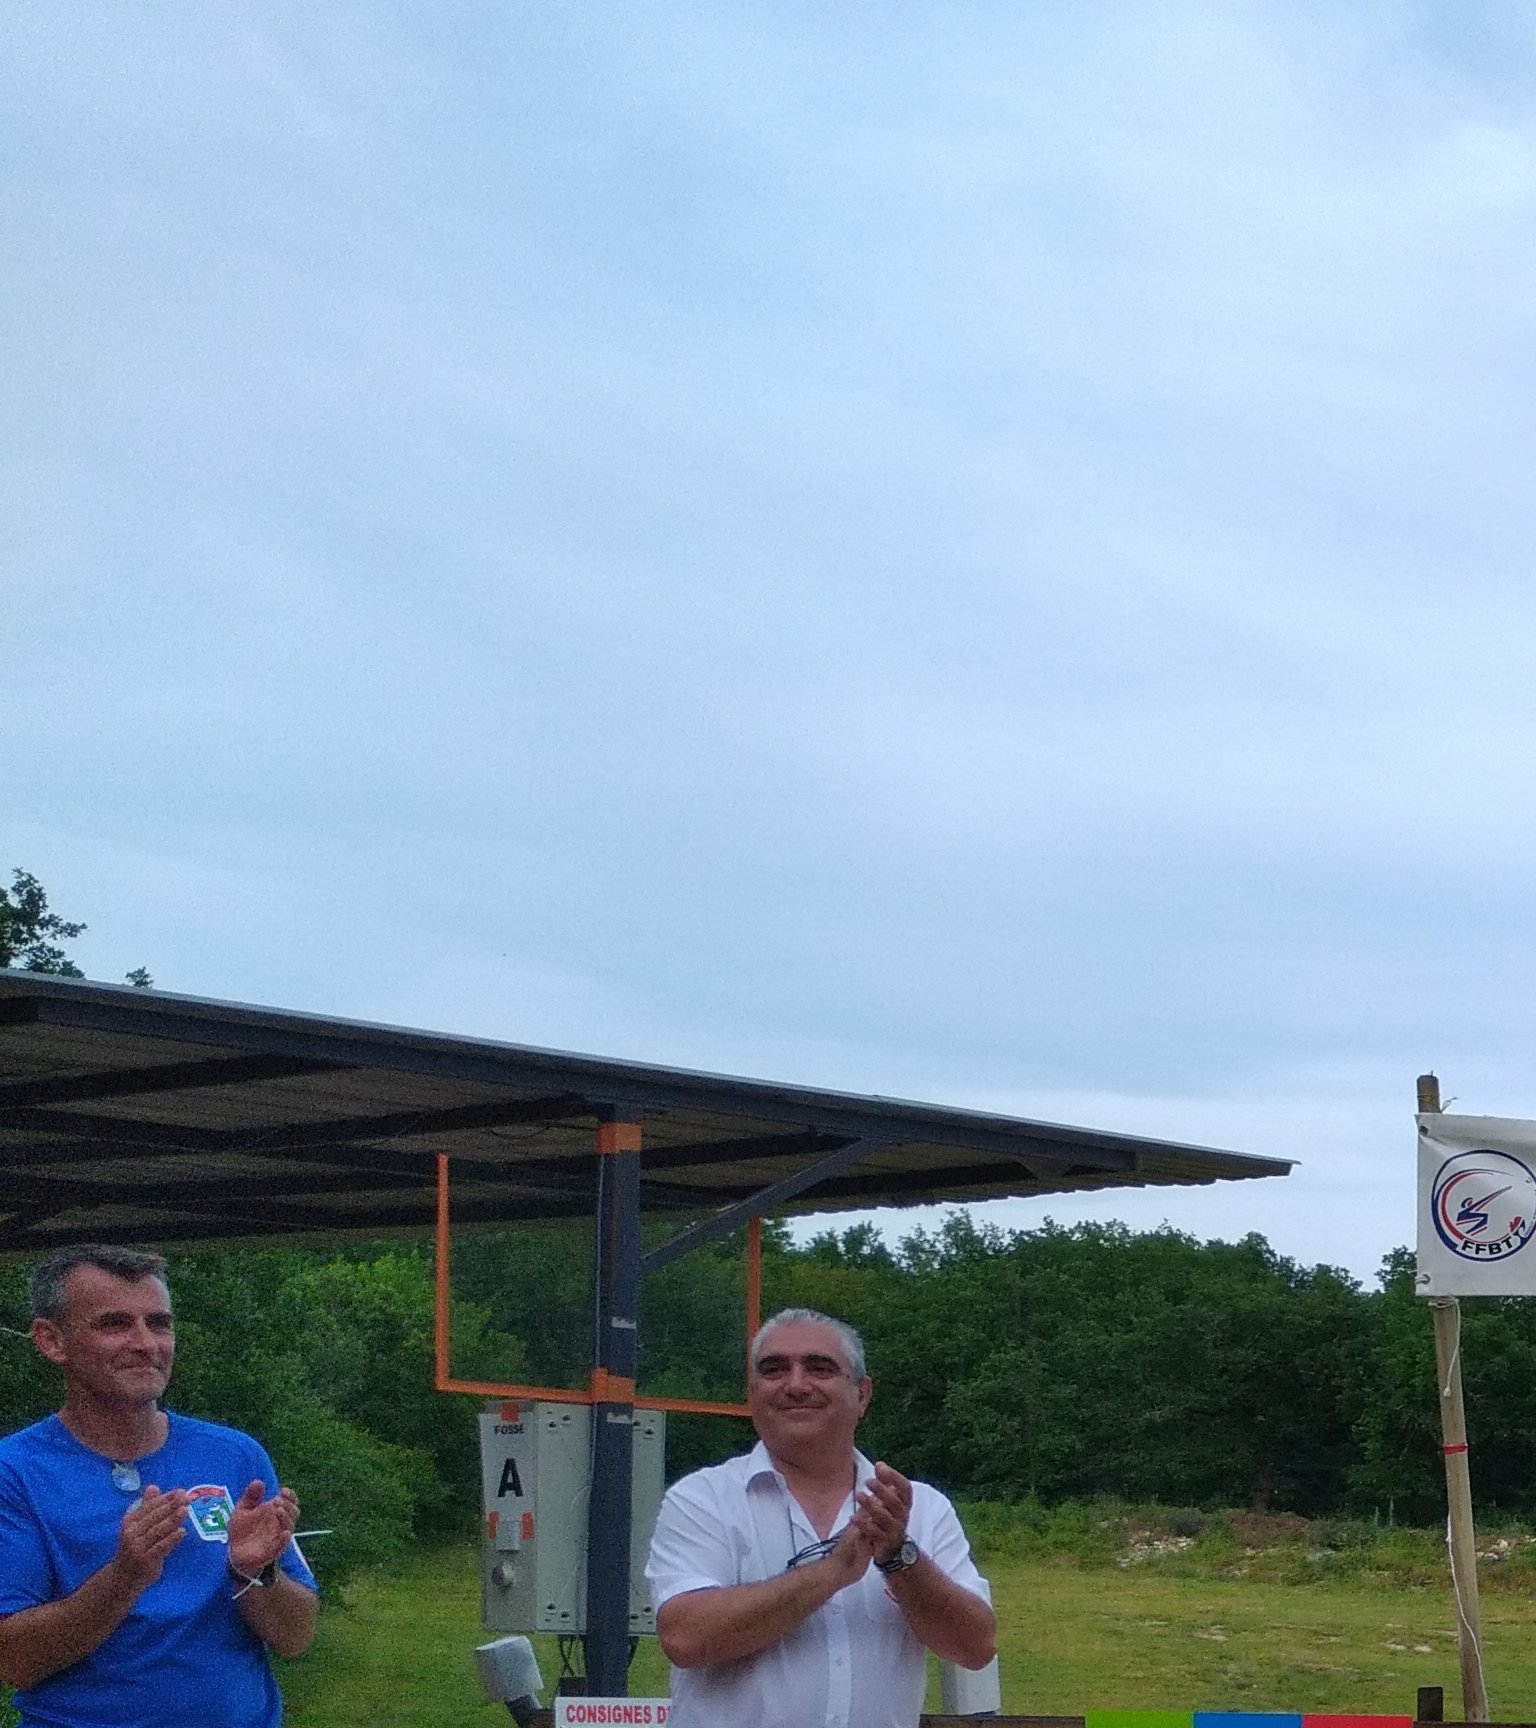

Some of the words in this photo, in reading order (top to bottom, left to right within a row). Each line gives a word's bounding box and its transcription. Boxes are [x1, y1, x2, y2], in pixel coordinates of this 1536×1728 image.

[1461, 1236, 1514, 1256] FFBT
[494, 1424, 525, 1435] FOSSE
[498, 1458, 524, 1498] A
[566, 1704, 652, 1724] CONSIGNES
